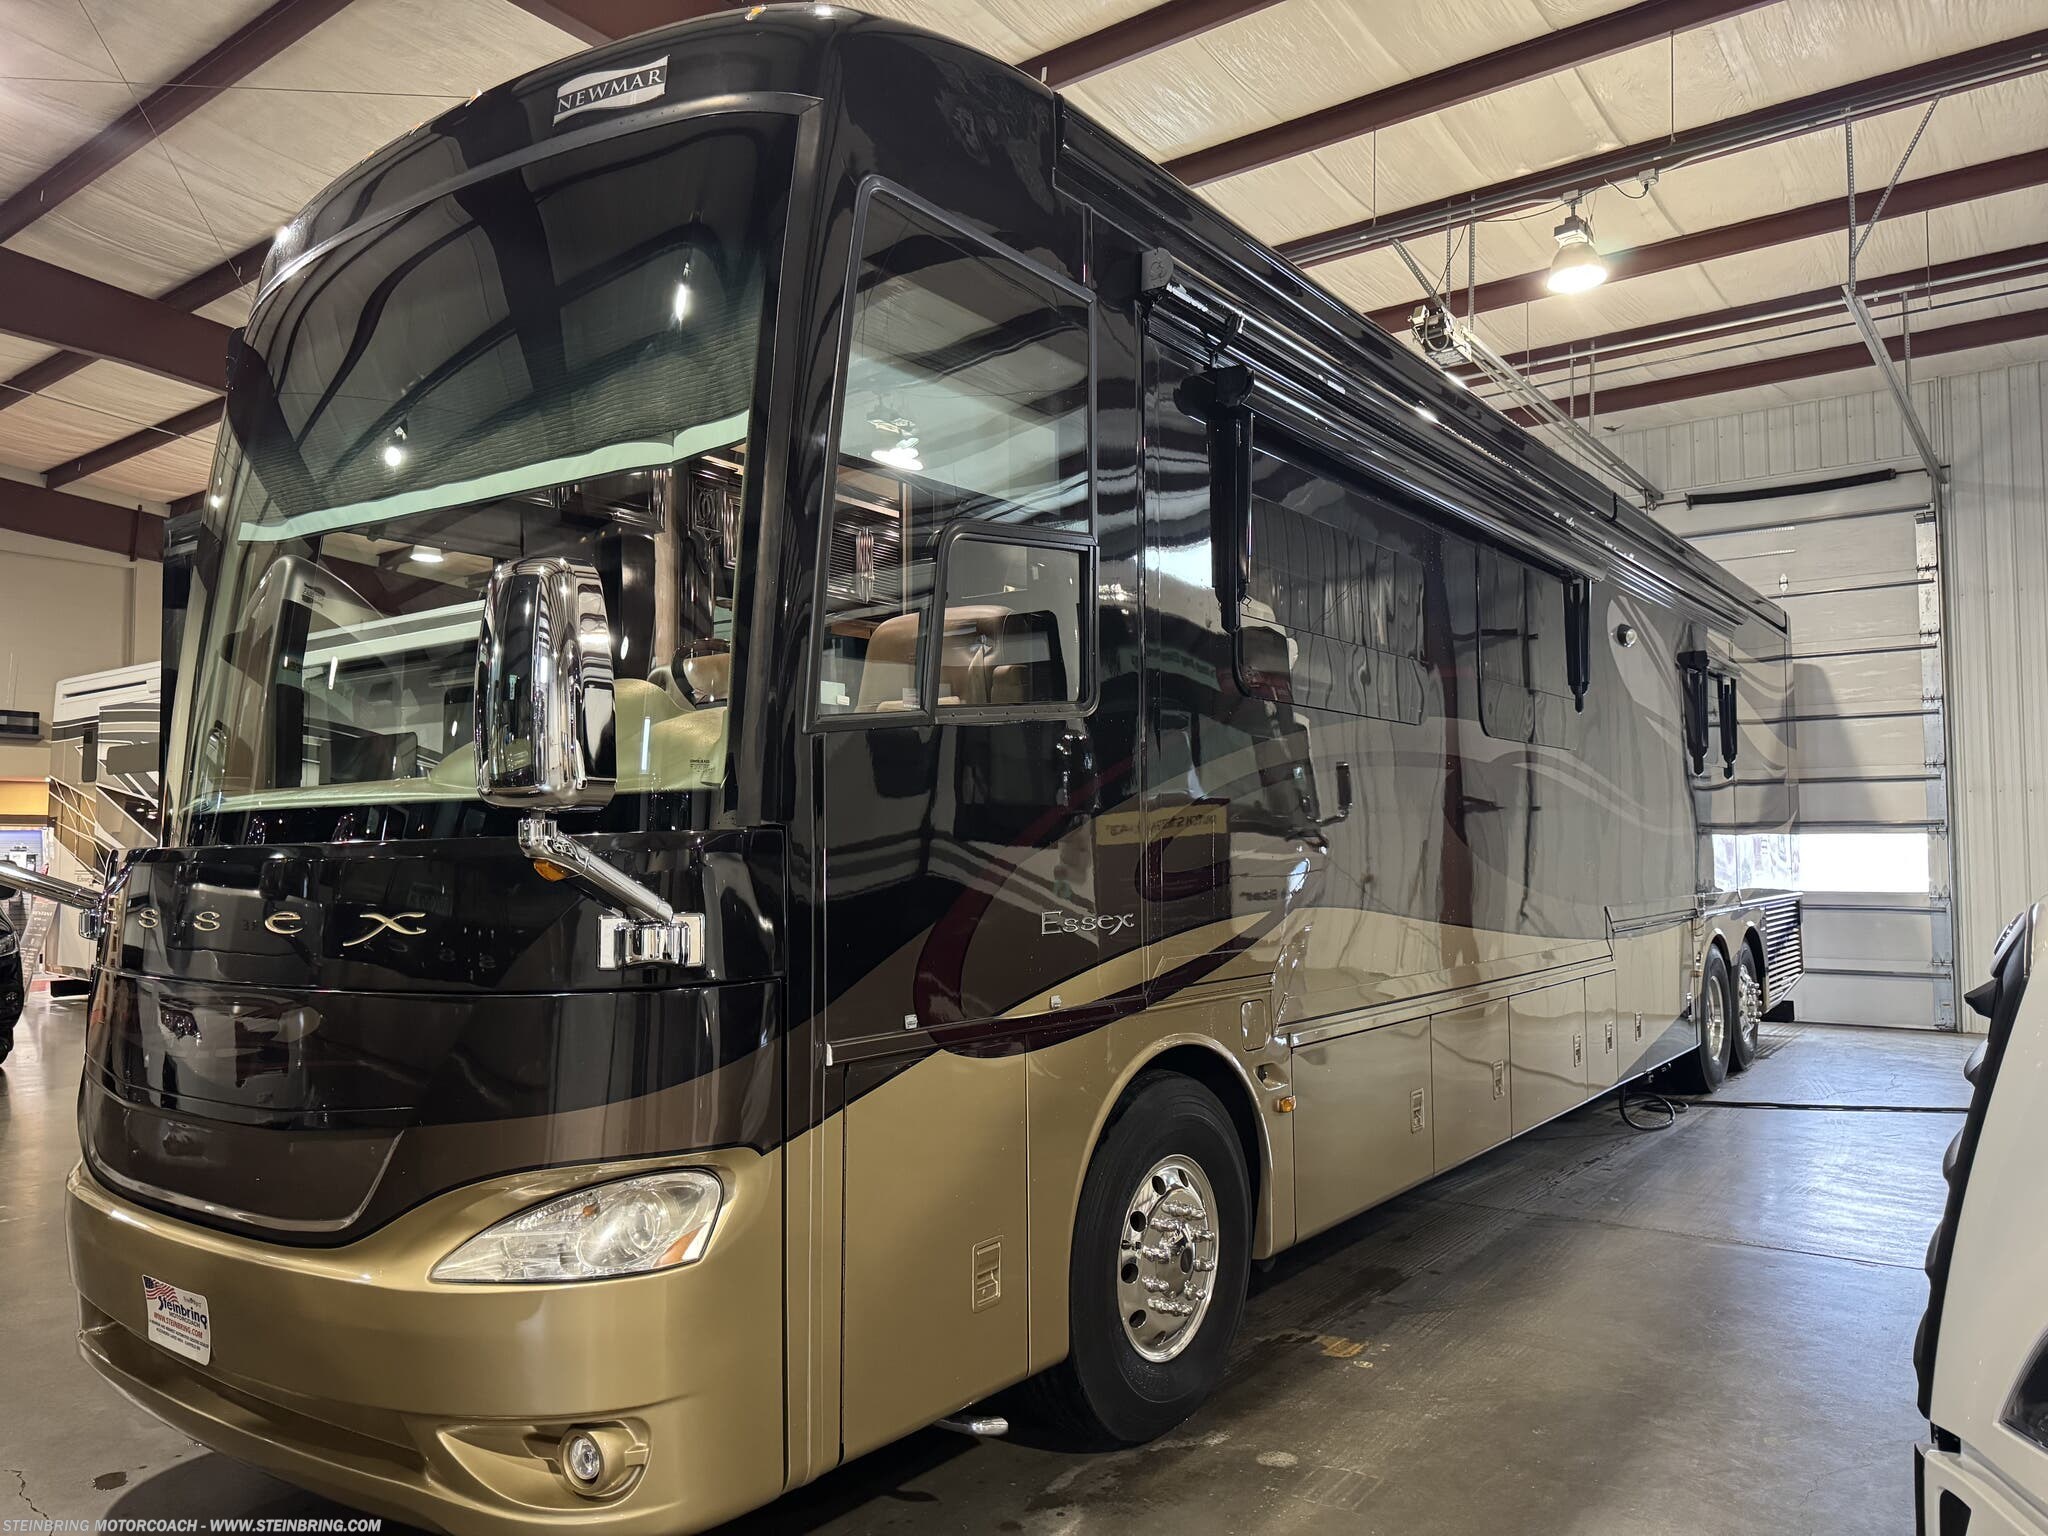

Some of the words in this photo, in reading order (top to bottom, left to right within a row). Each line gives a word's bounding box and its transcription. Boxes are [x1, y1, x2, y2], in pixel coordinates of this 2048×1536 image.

[558, 69, 664, 113] NEWMAR
[1041, 910, 1135, 936] Essex
[153, 1311, 203, 1339] WWW.STEINBRING.COM
[158, 1296, 208, 1330] Steinbring
